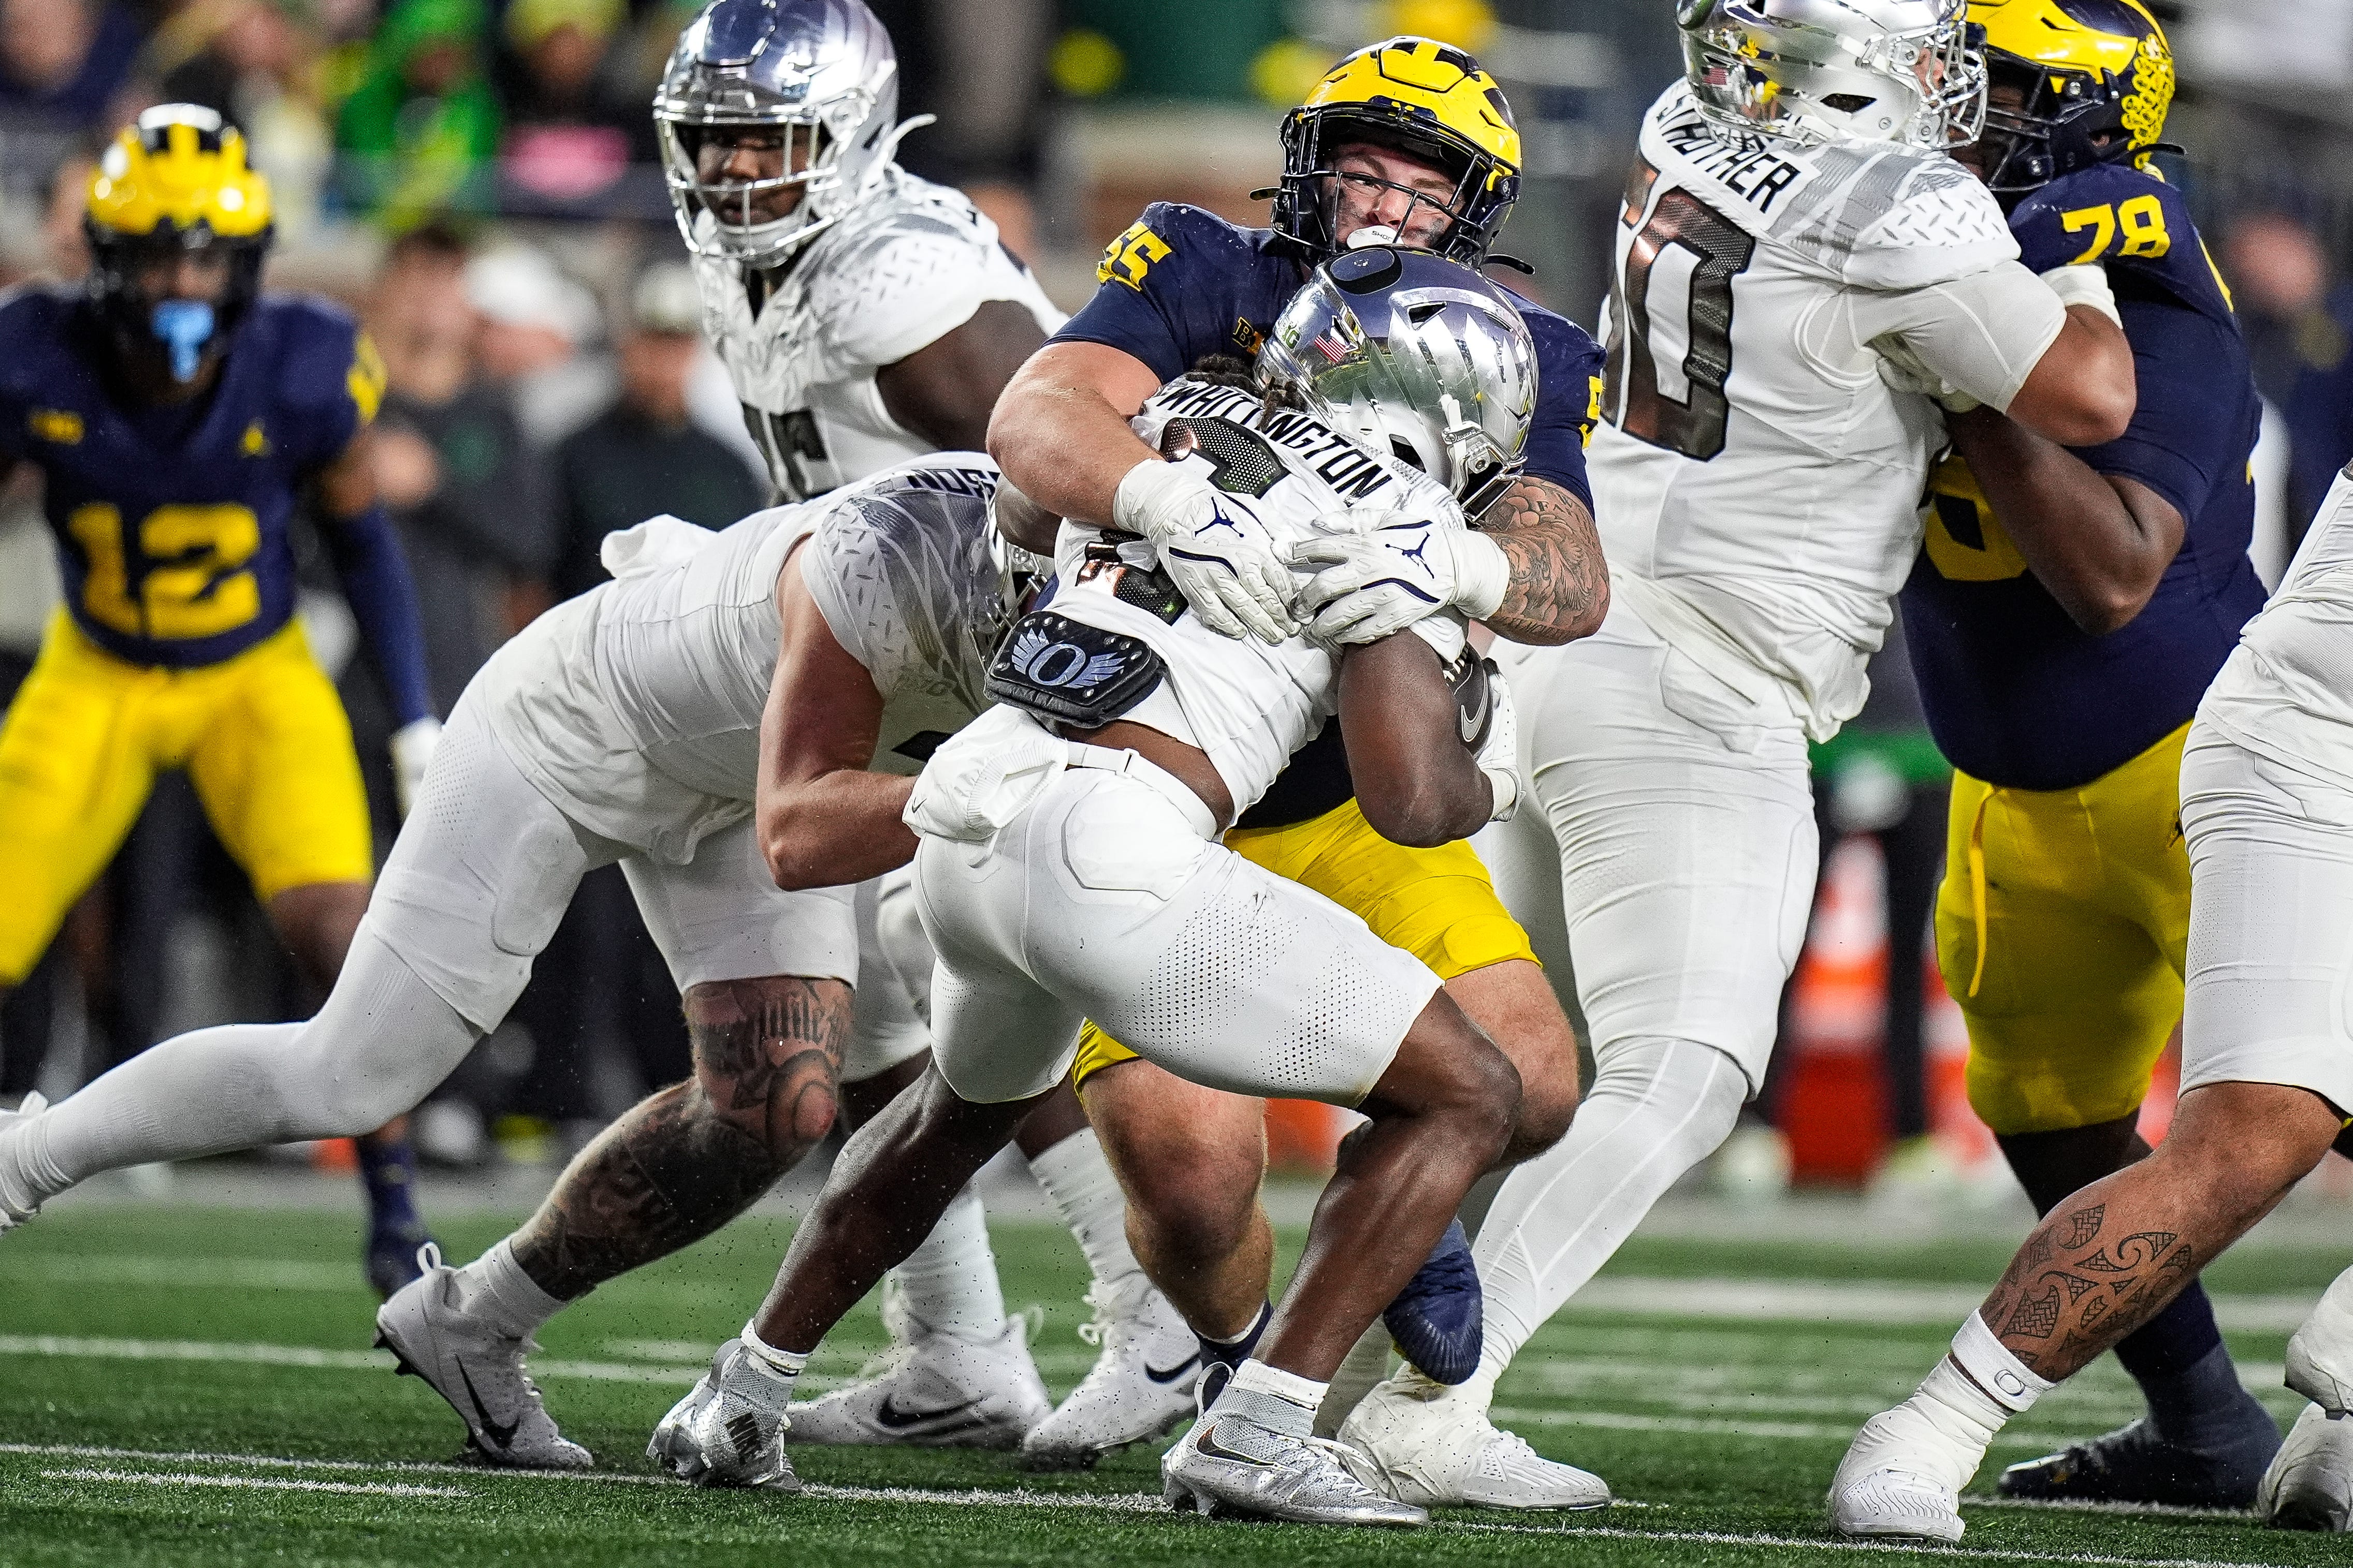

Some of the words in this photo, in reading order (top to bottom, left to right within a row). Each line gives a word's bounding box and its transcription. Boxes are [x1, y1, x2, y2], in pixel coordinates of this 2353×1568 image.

[1097, 221, 1172, 291] 55
[2060, 194, 2171, 265] 78
[1156, 385, 1392, 508] WHITTNGTON
[69, 502, 260, 640] 12
